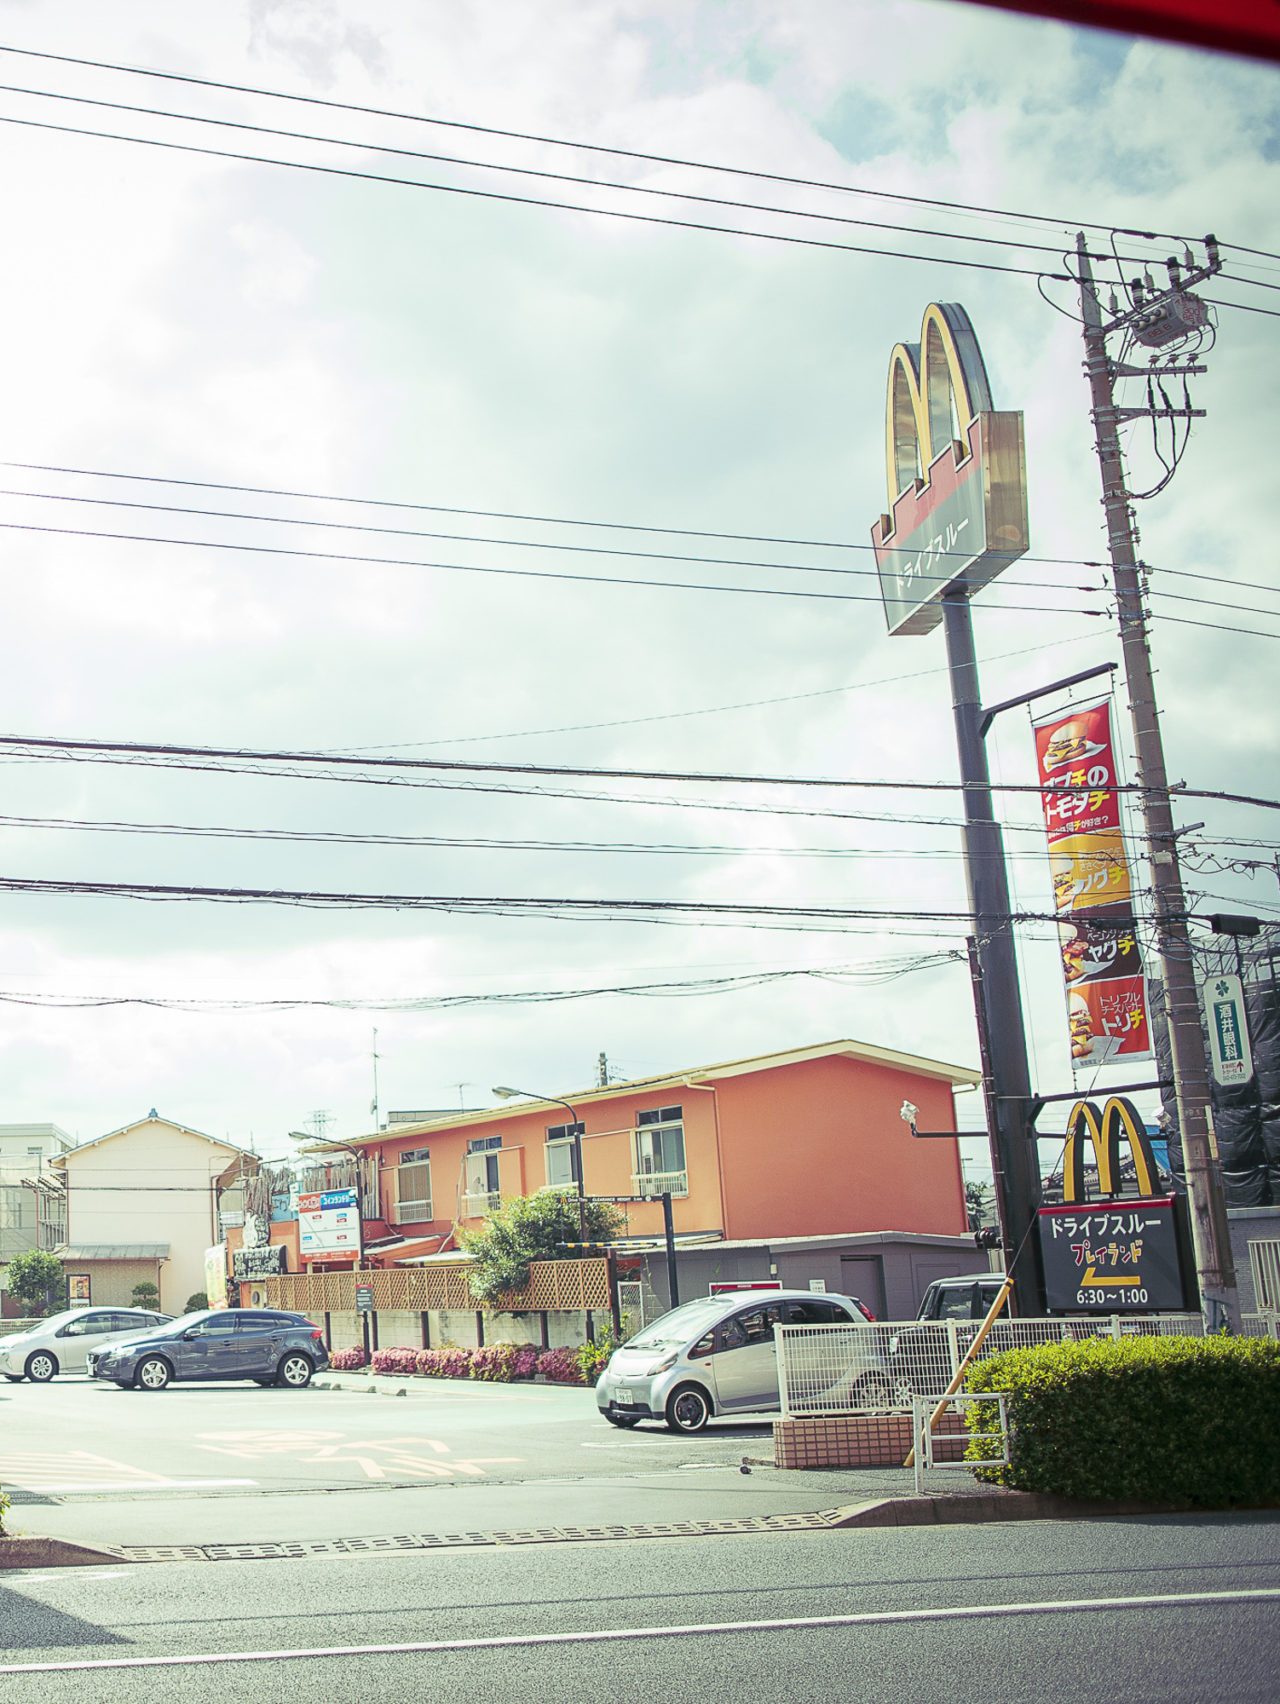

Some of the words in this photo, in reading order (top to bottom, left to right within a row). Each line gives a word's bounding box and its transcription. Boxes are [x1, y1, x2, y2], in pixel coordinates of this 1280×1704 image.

[896, 518, 969, 597] ドライブスルー
[1088, 936, 1135, 963] ヤグチ
[1099, 992, 1141, 1008] トリプル
[1102, 1010, 1144, 1036] トリチ
[1219, 1003, 1238, 1060] 酒井眼科
[1051, 1213, 1162, 1239] ドライブスルー
[1070, 1239, 1144, 1267] プレイランド
